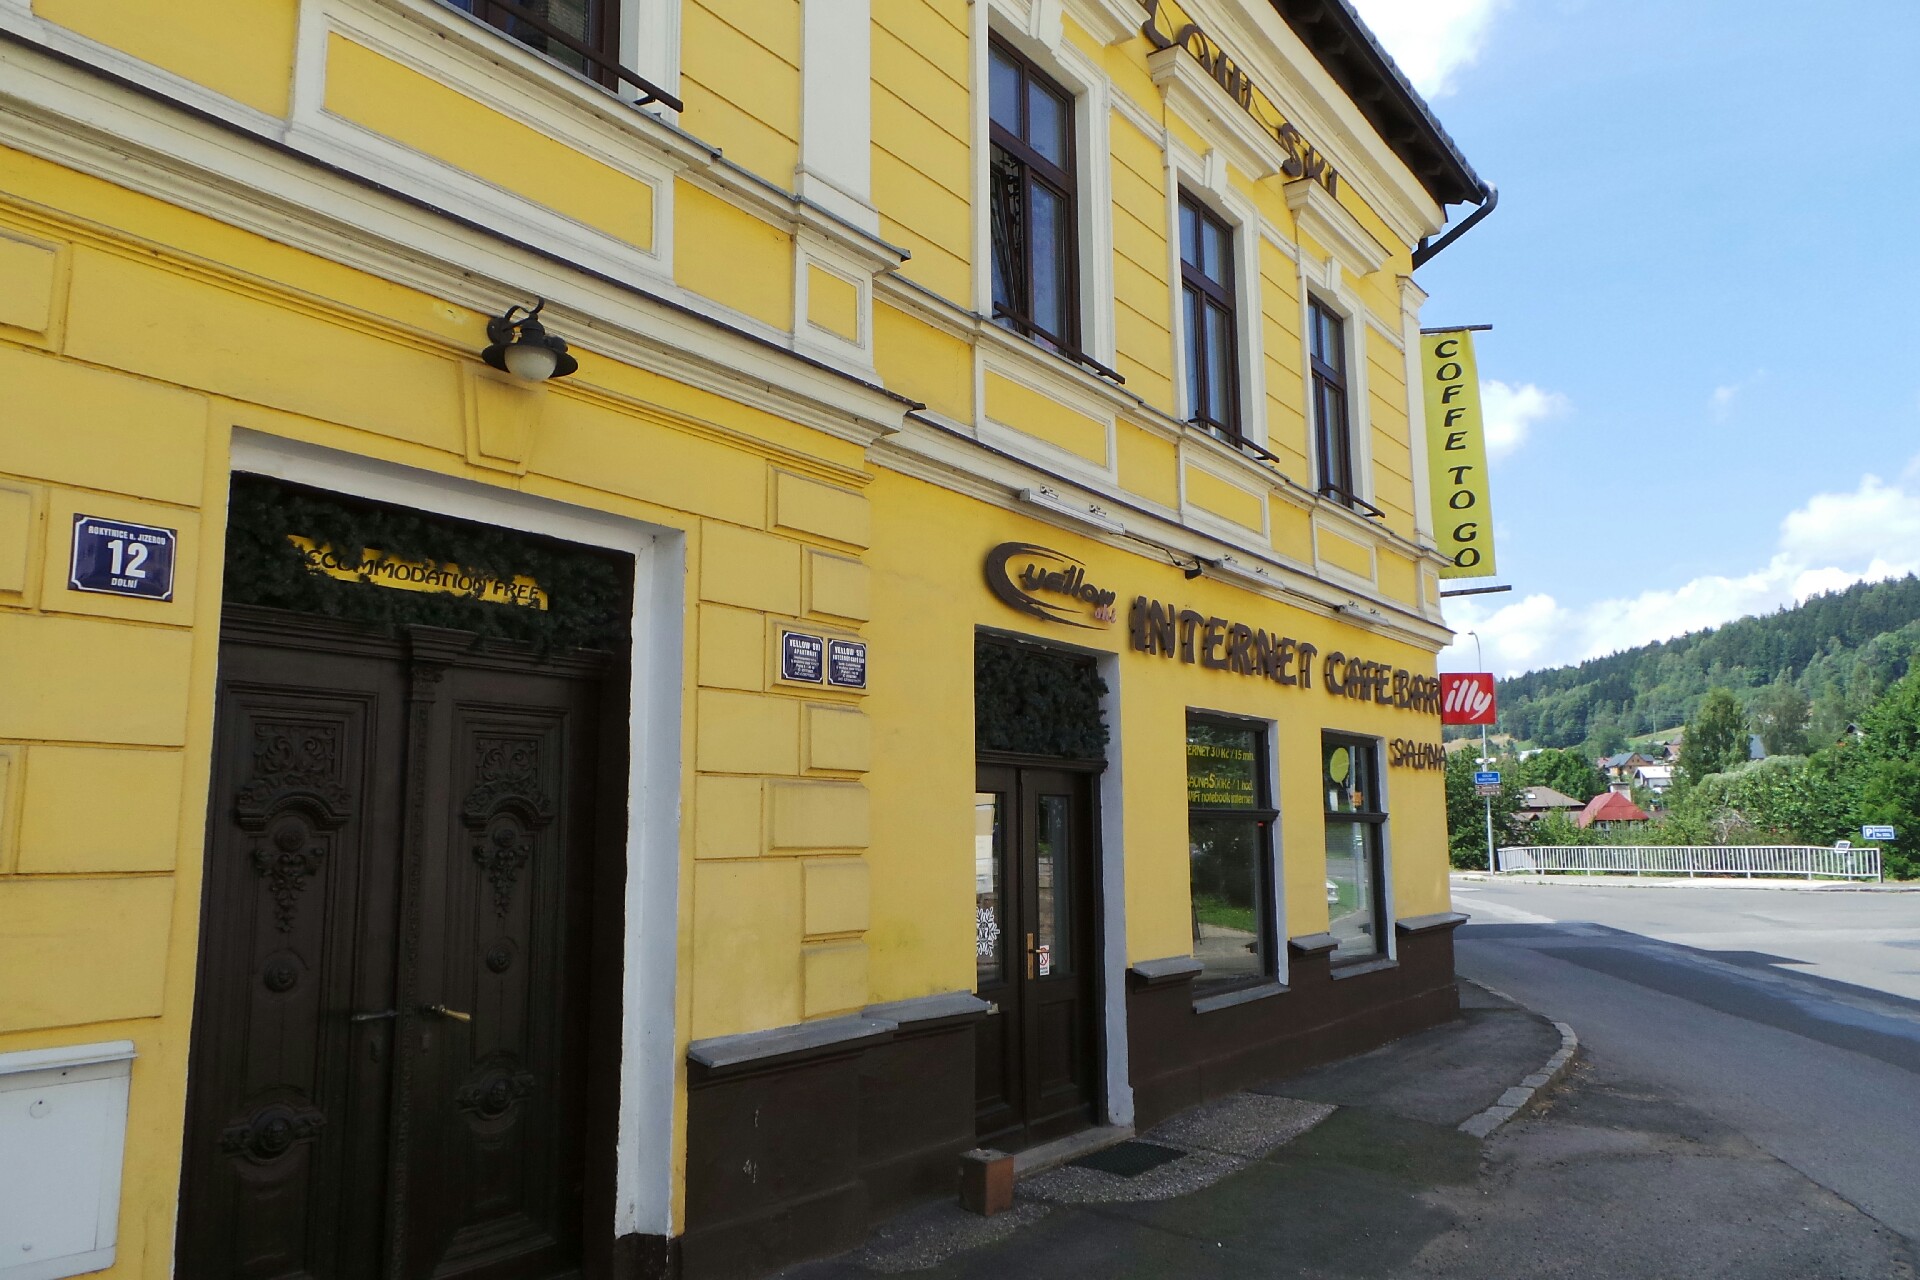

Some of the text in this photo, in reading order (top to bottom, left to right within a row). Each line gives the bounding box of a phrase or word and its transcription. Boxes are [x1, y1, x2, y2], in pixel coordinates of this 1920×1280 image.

[1280, 122, 1338, 198] SKI
[1435, 340, 1468, 451] COFFE
[88, 525, 128, 540] ROKYTNICE
[137, 533, 166, 546] JIZEROU
[107, 539, 149, 579] 12
[303, 548, 487, 593] CCOMMODATION
[110, 577, 138, 589] DOLNÍ
[1130, 595, 1318, 688] INTERNET
[1445, 679, 1492, 720] illy
[1390, 738, 1446, 771] SAUNA
